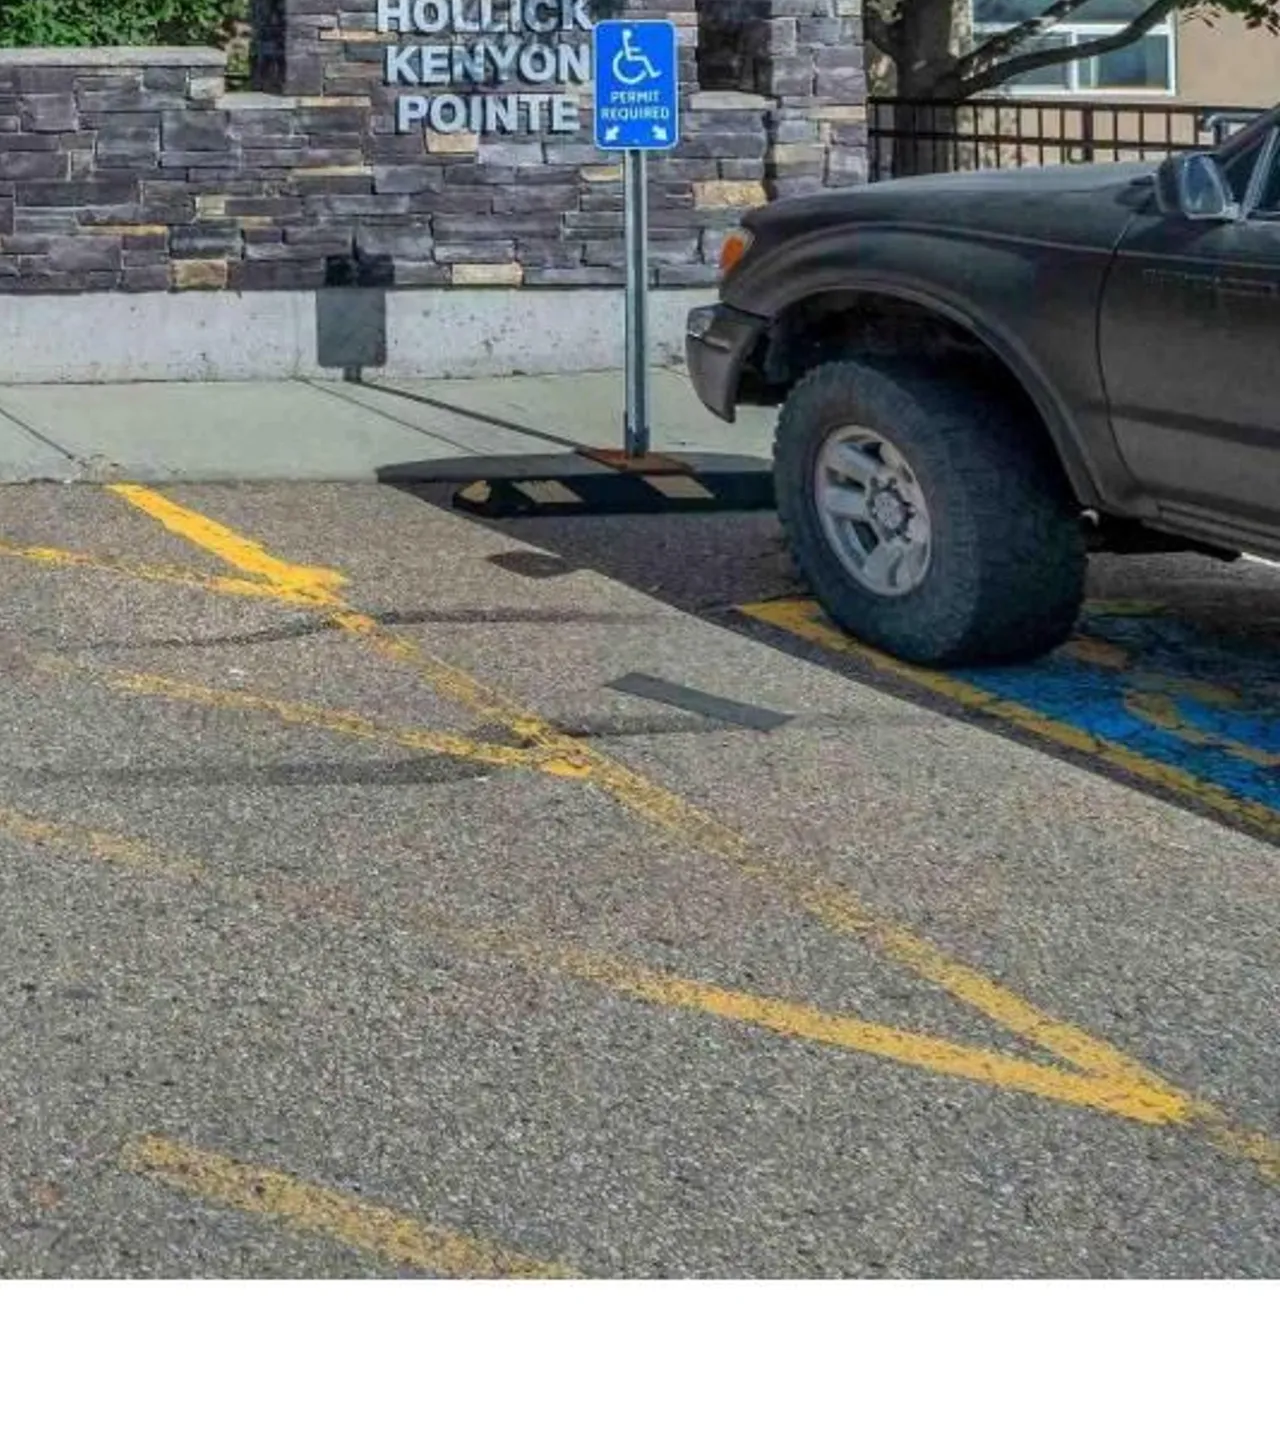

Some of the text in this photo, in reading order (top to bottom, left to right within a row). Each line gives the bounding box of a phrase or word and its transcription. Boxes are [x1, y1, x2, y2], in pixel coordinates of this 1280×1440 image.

[386, 45, 590, 84] KENYON
[610, 91, 659, 104] PERMIT
[397, 94, 580, 133] POINTE
[601, 107, 670, 121] REQUIRED
